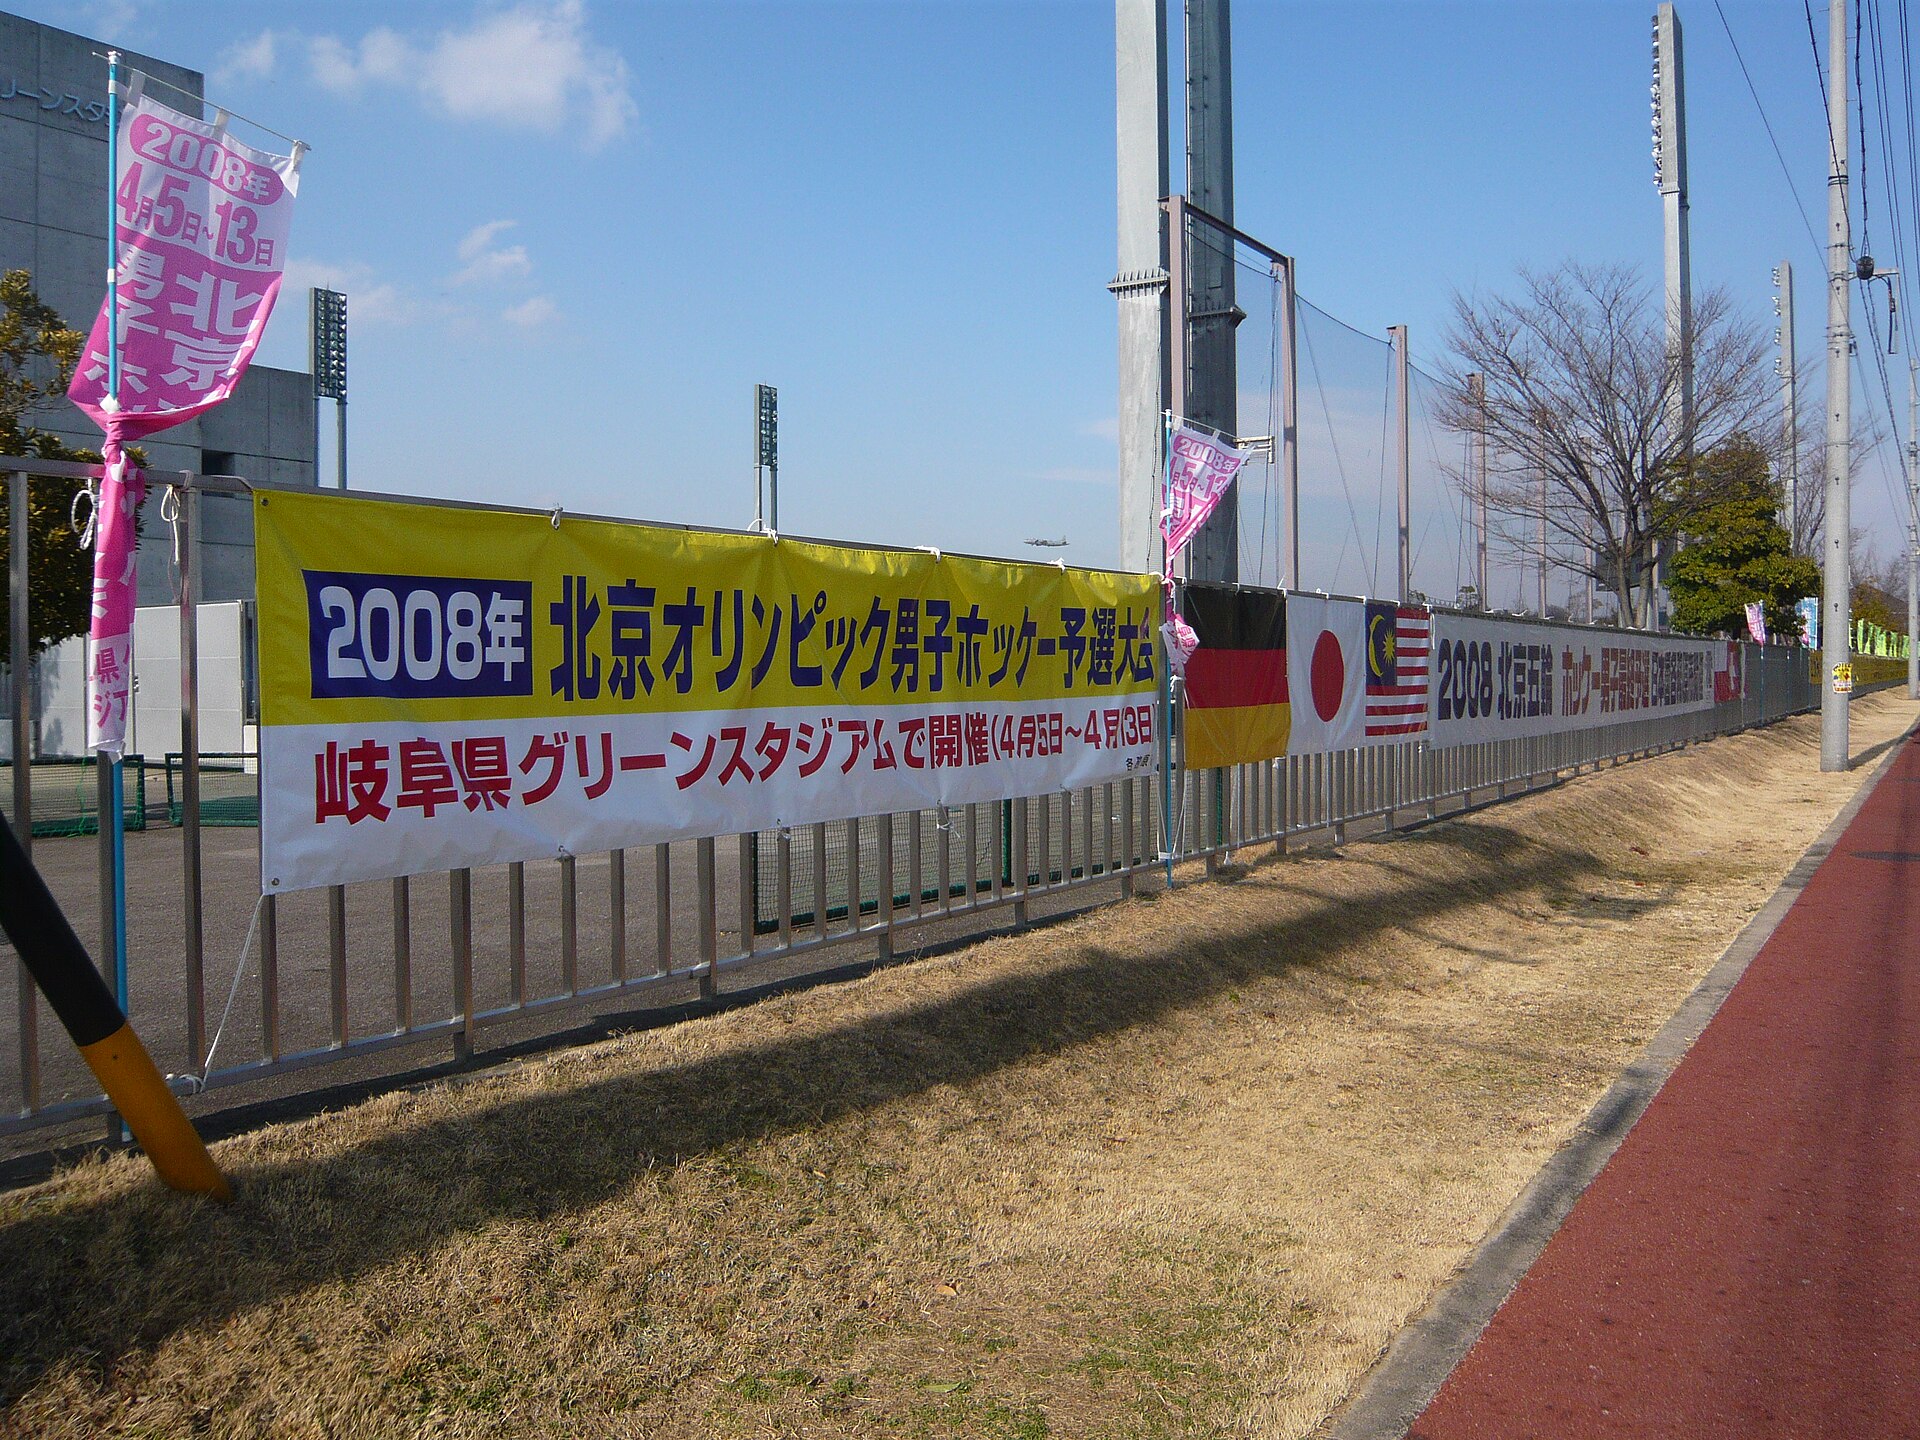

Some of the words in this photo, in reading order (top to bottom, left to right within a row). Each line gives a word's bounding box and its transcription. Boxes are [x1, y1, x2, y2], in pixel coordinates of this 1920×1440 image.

[140, 122, 271, 200] 2008年
[1176, 438, 1236, 473] 2008年
[319, 585, 525, 682] 2008年
[549, 575, 1155, 702] 北京オリンピック男子ホッケー予選大会
[1437, 638, 1493, 720] 2008
